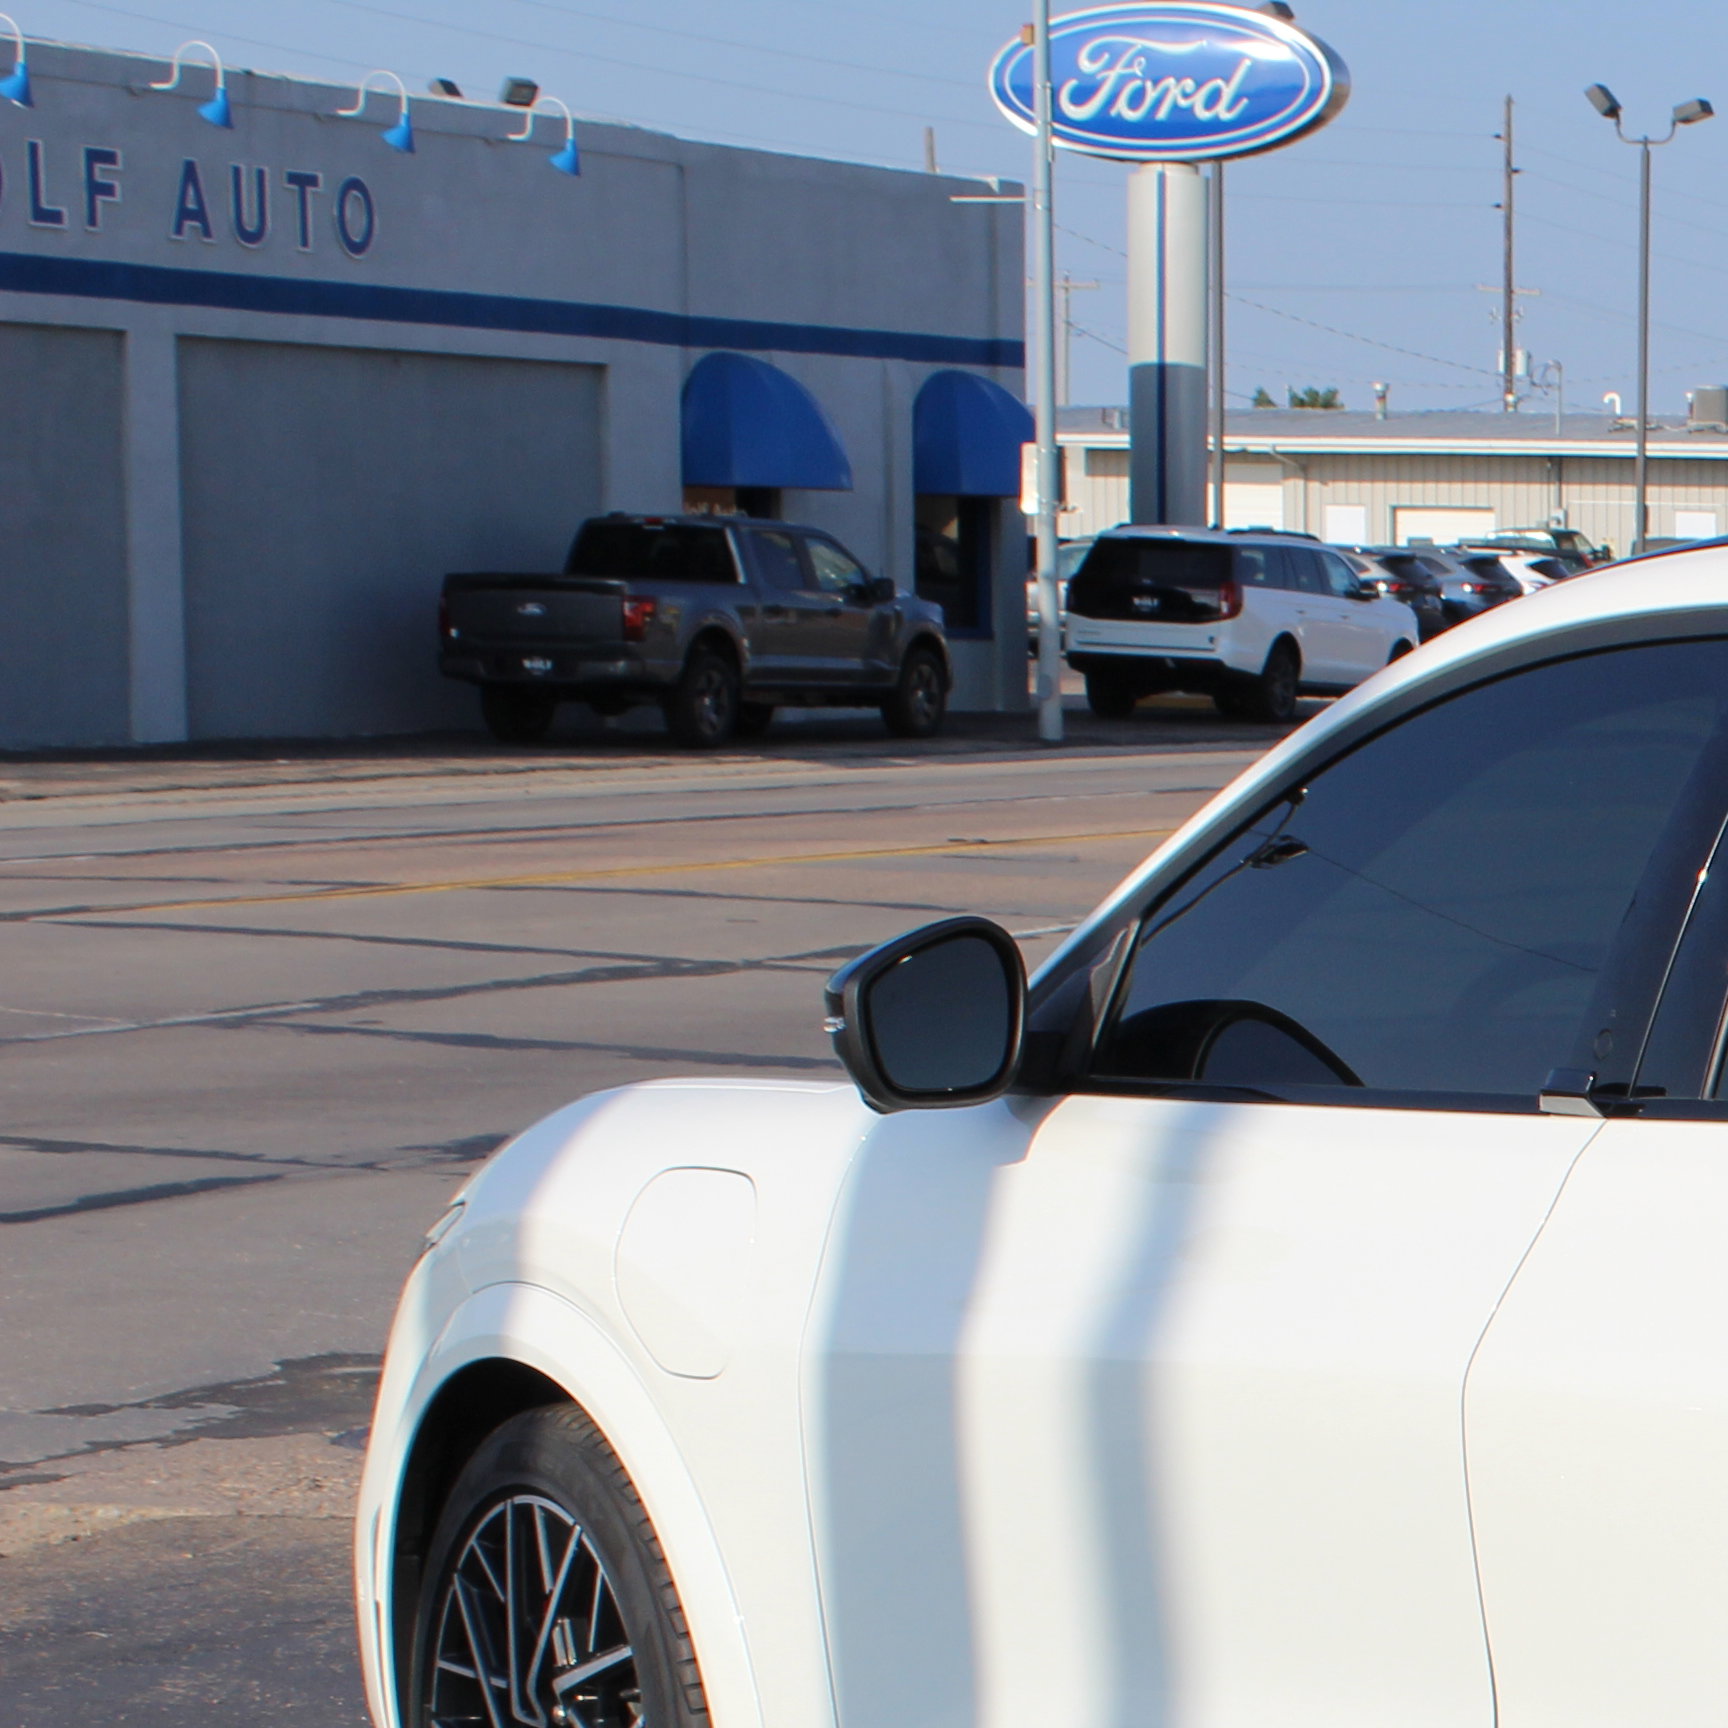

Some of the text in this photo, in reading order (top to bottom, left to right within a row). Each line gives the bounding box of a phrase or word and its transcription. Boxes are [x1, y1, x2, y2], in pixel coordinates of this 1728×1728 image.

[1059, 36, 1252, 122] Ford
[0, 138, 377, 256] LF AUTO
